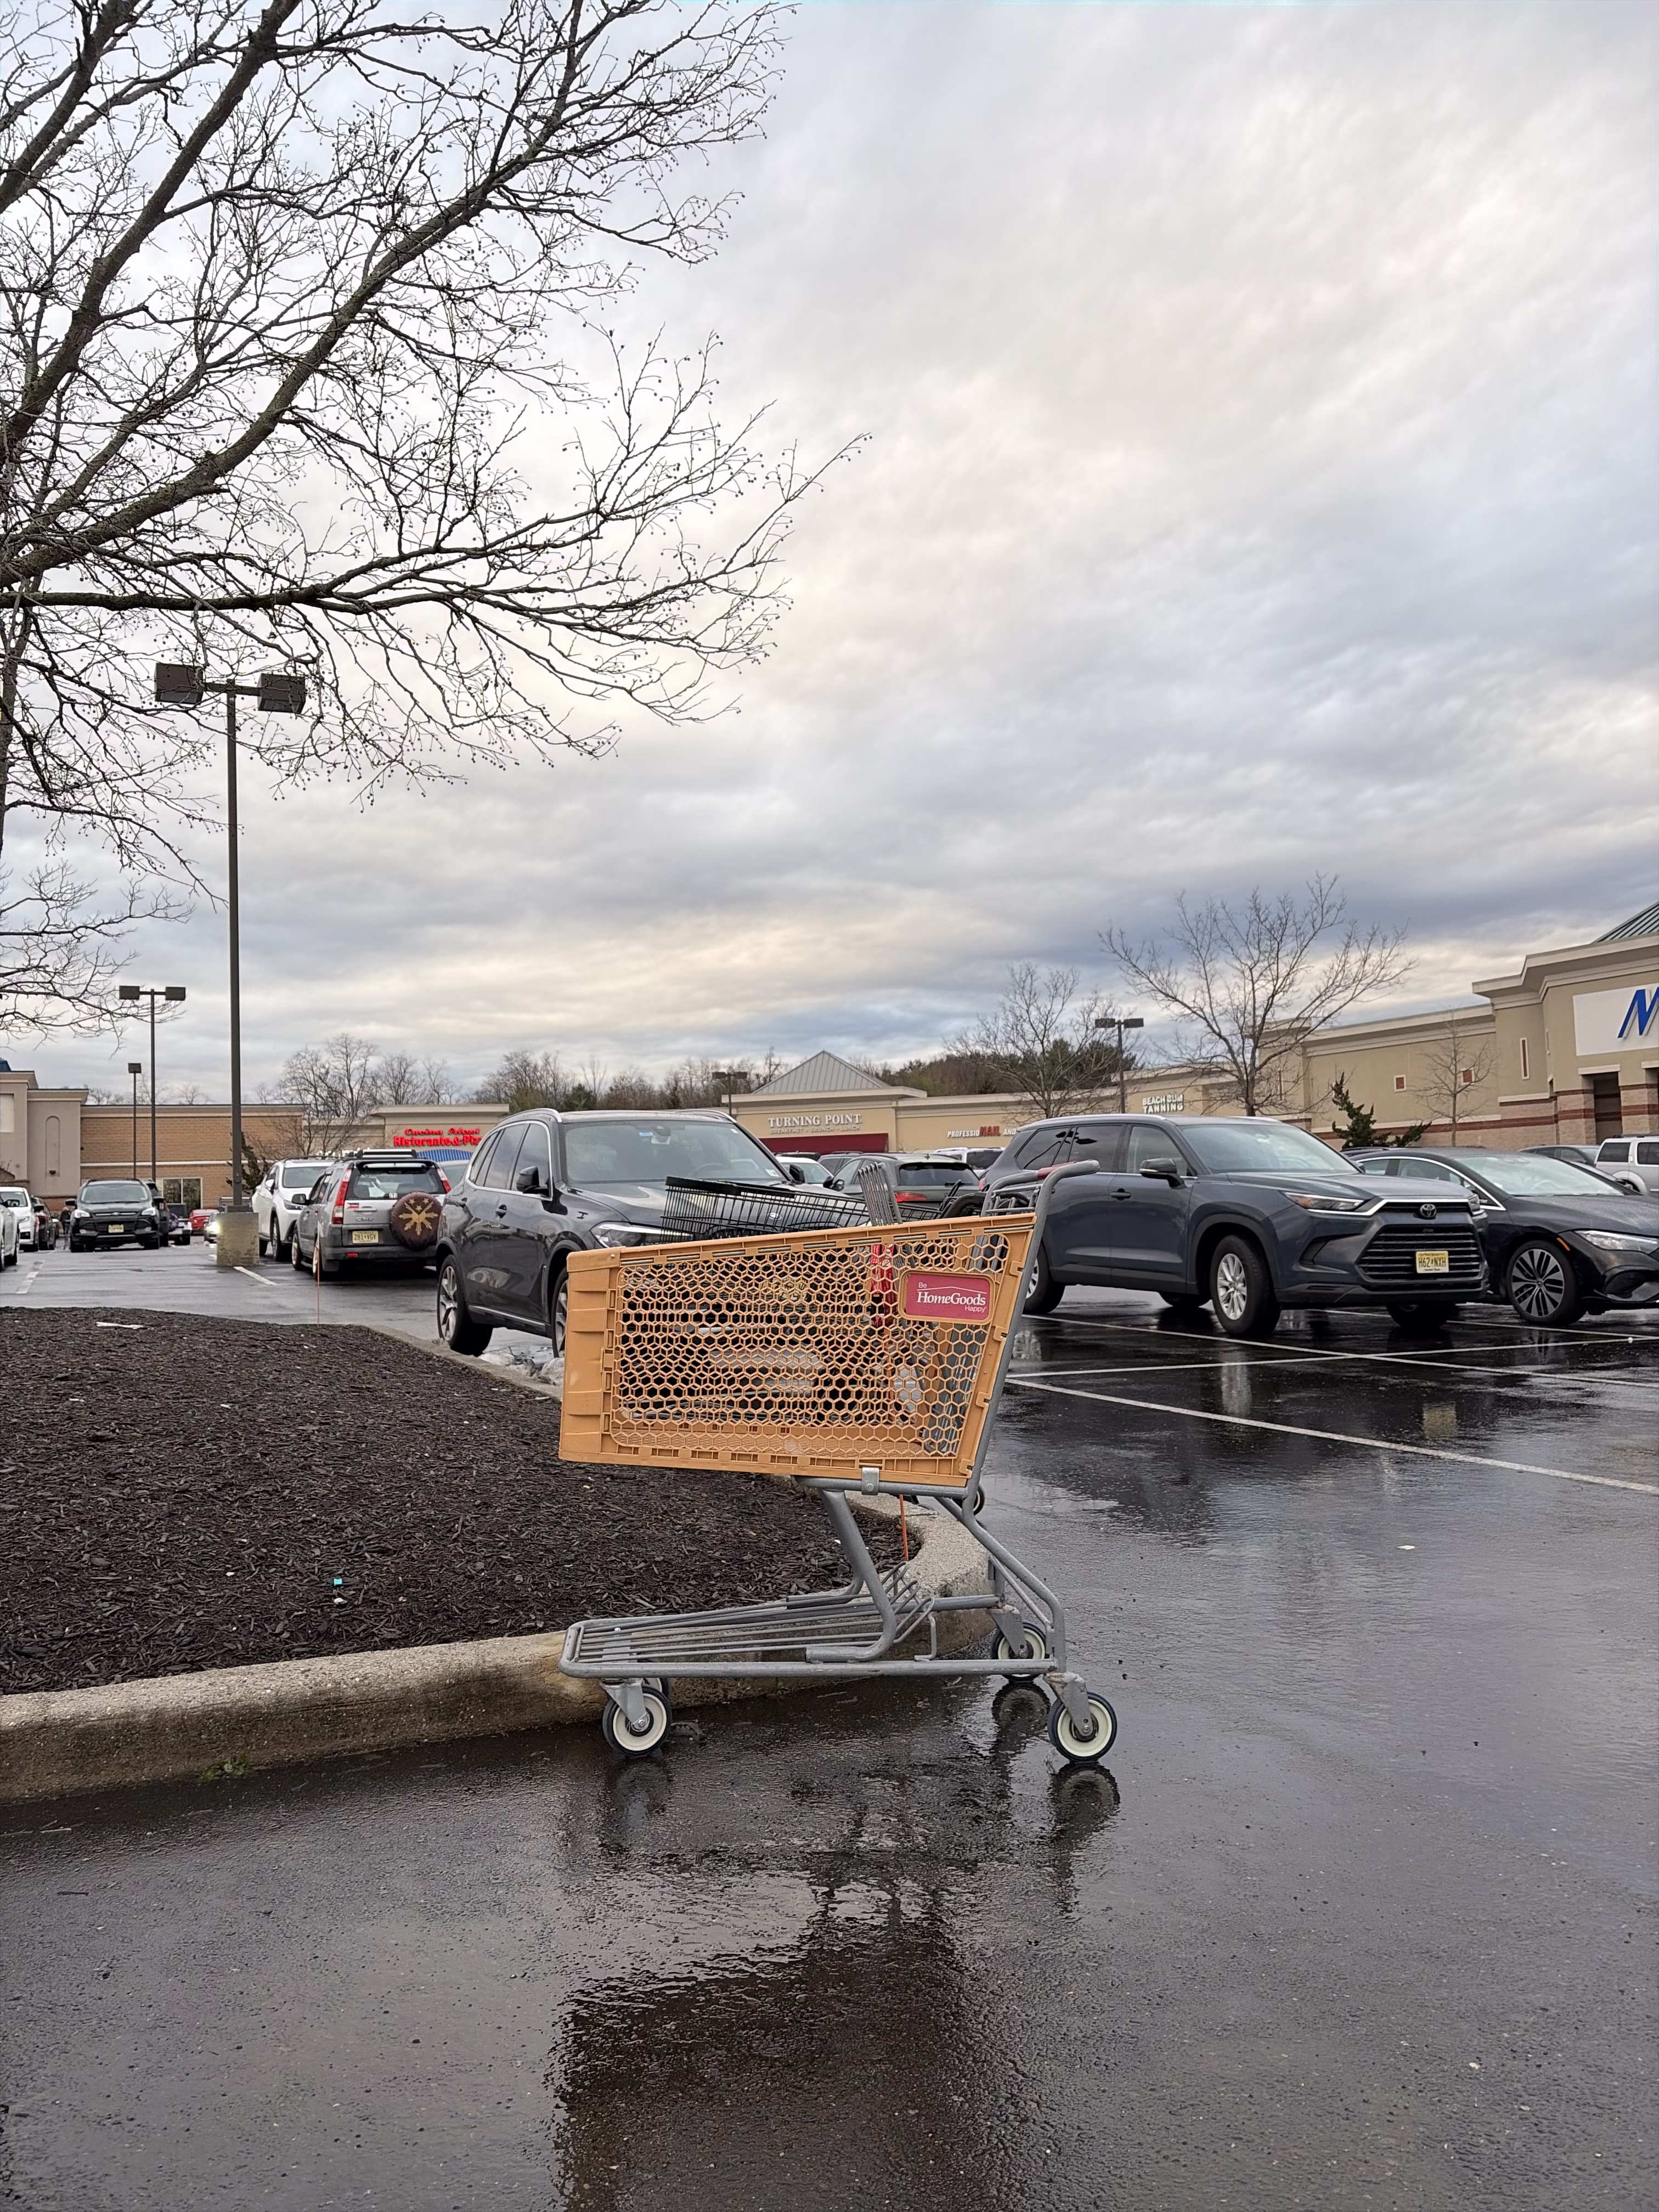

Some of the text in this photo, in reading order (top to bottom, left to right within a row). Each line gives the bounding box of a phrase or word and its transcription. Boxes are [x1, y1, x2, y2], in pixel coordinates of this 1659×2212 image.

[1143, 1094, 1183, 1105] BEACH BUM
[1143, 1103, 1184, 1114] TANNING
[769, 1114, 861, 1128] TURNING POINT
[394, 1135, 451, 1147] Ristorante
[917, 1291, 986, 1306] HomeGoods
